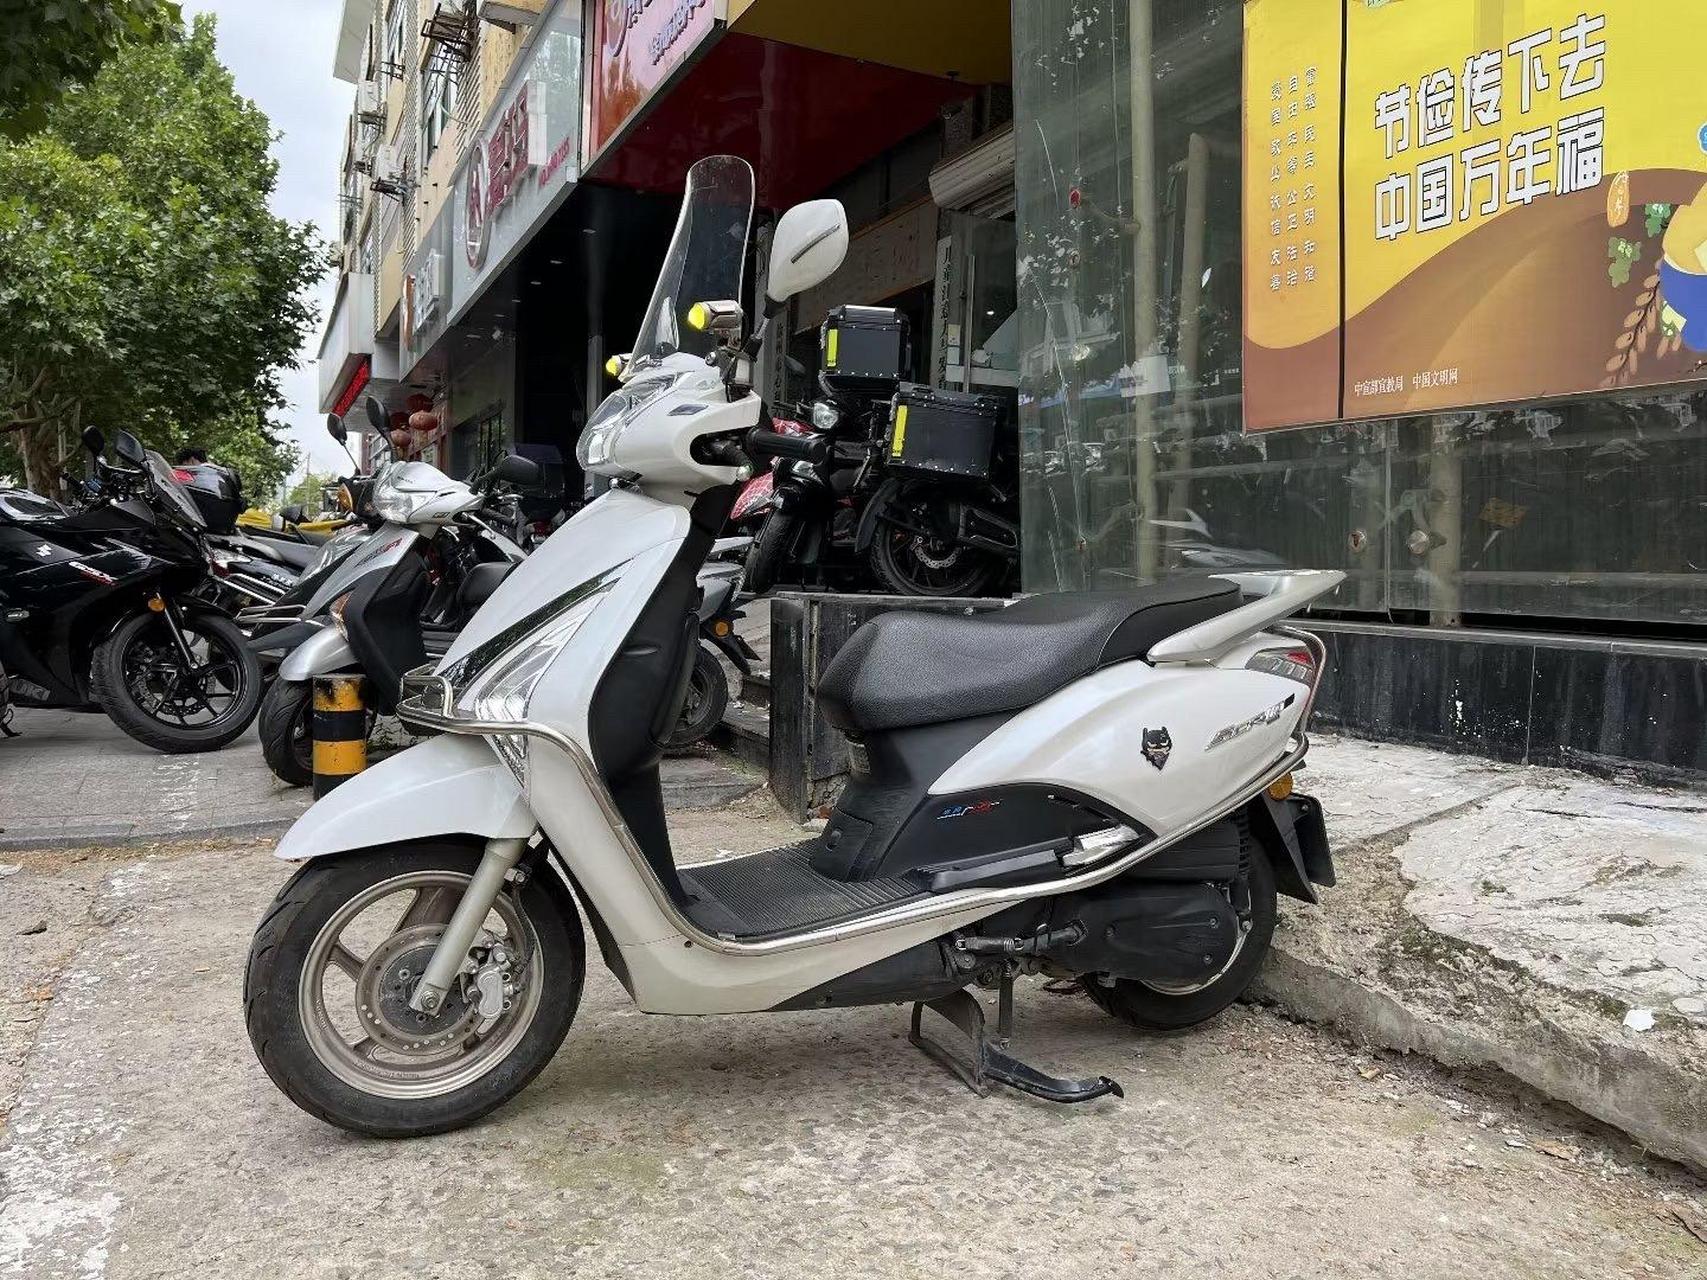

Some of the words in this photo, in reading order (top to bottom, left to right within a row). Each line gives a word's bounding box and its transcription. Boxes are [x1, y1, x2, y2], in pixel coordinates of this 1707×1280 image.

[1375, 13, 1606, 159] 节俭传下去
[1374, 107, 1605, 241] 中国万年福
[1354, 375, 1404, 397] 中宣部宣教局
[1412, 367, 1458, 390] 中国文明网
